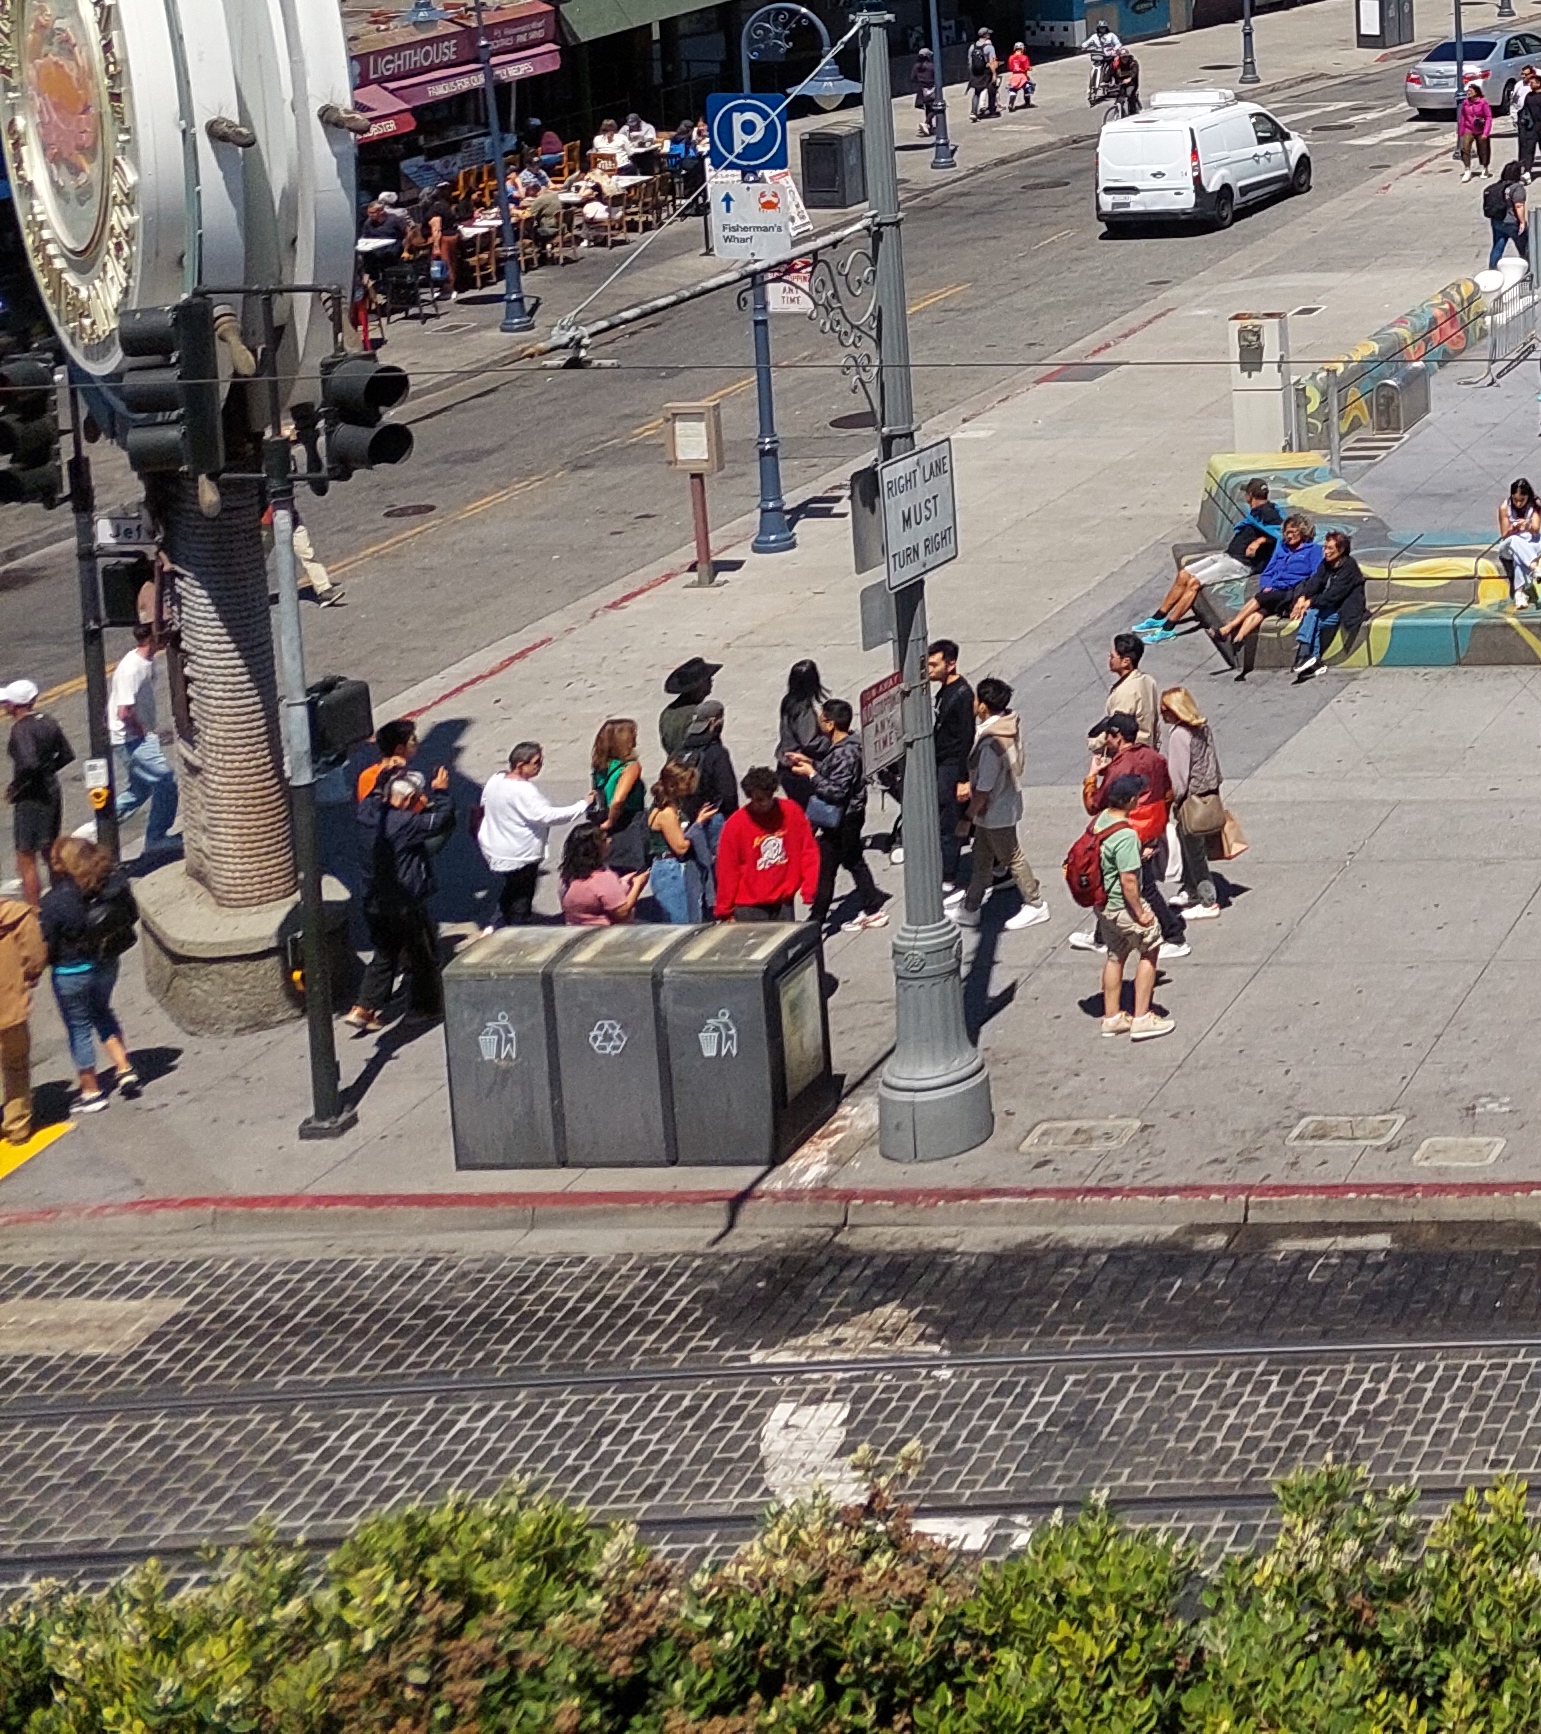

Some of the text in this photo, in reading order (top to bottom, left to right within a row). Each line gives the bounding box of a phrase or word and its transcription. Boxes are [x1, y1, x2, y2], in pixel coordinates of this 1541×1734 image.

[369, 39, 458, 79] LIGHTHOUSE
[722, 223, 783, 233] Fisherman's
[722, 235, 754, 244] Wharf
[781, 295, 802, 305] TIME
[886, 455, 949, 500] RIGHT LANE
[901, 493, 939, 533] MUST
[892, 526, 953, 574] TURN RIGHT
